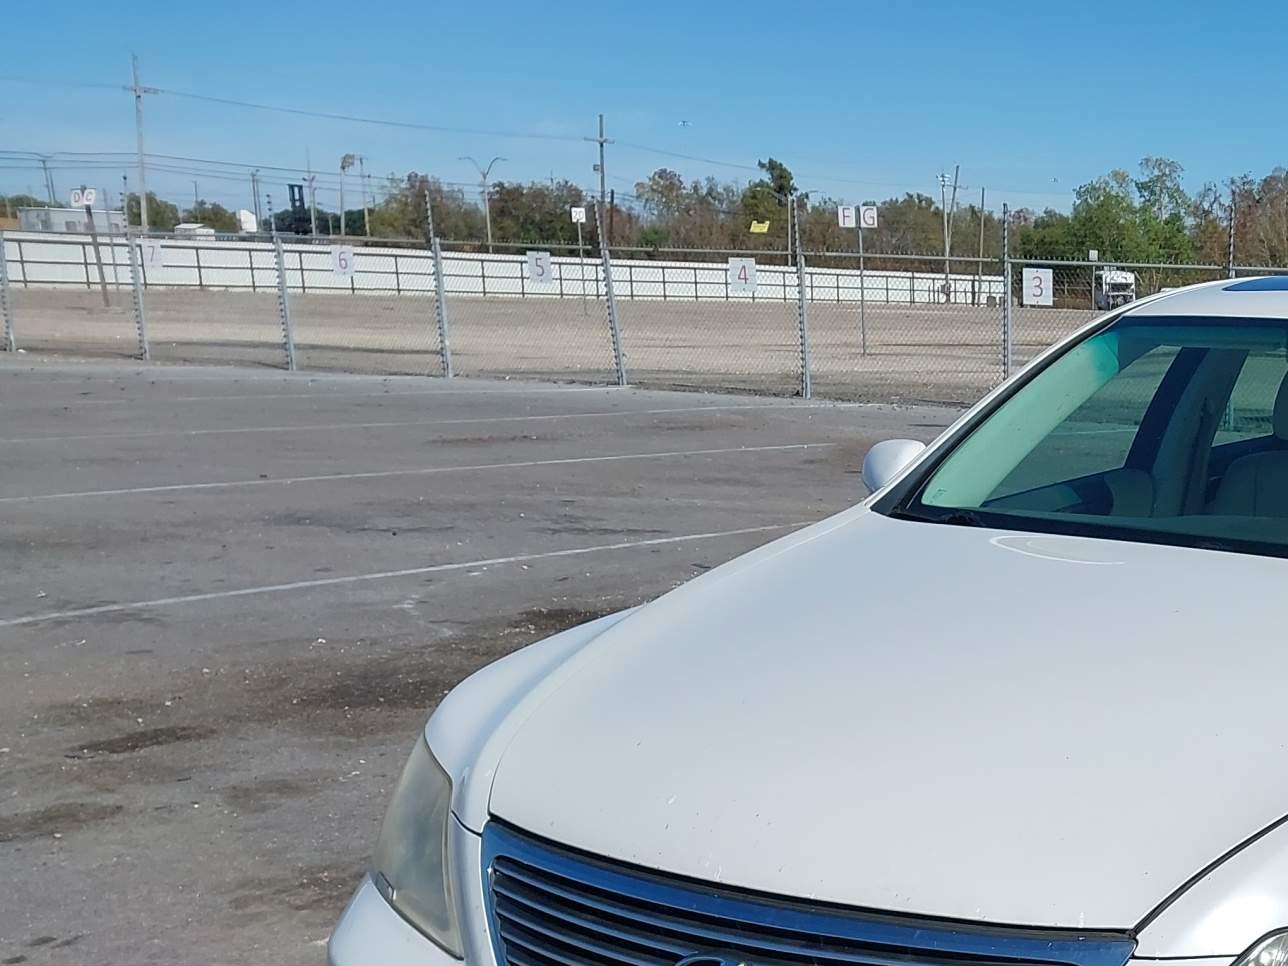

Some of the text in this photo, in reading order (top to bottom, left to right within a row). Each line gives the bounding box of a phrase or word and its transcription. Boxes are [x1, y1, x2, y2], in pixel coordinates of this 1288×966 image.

[842, 207, 851, 226] F
[862, 207, 875, 226] G
[147, 245, 155, 263] 7
[338, 250, 348, 270] 6
[535, 257, 545, 277] 5
[737, 264, 749, 285] 4
[1032, 275, 1044, 298] 3
